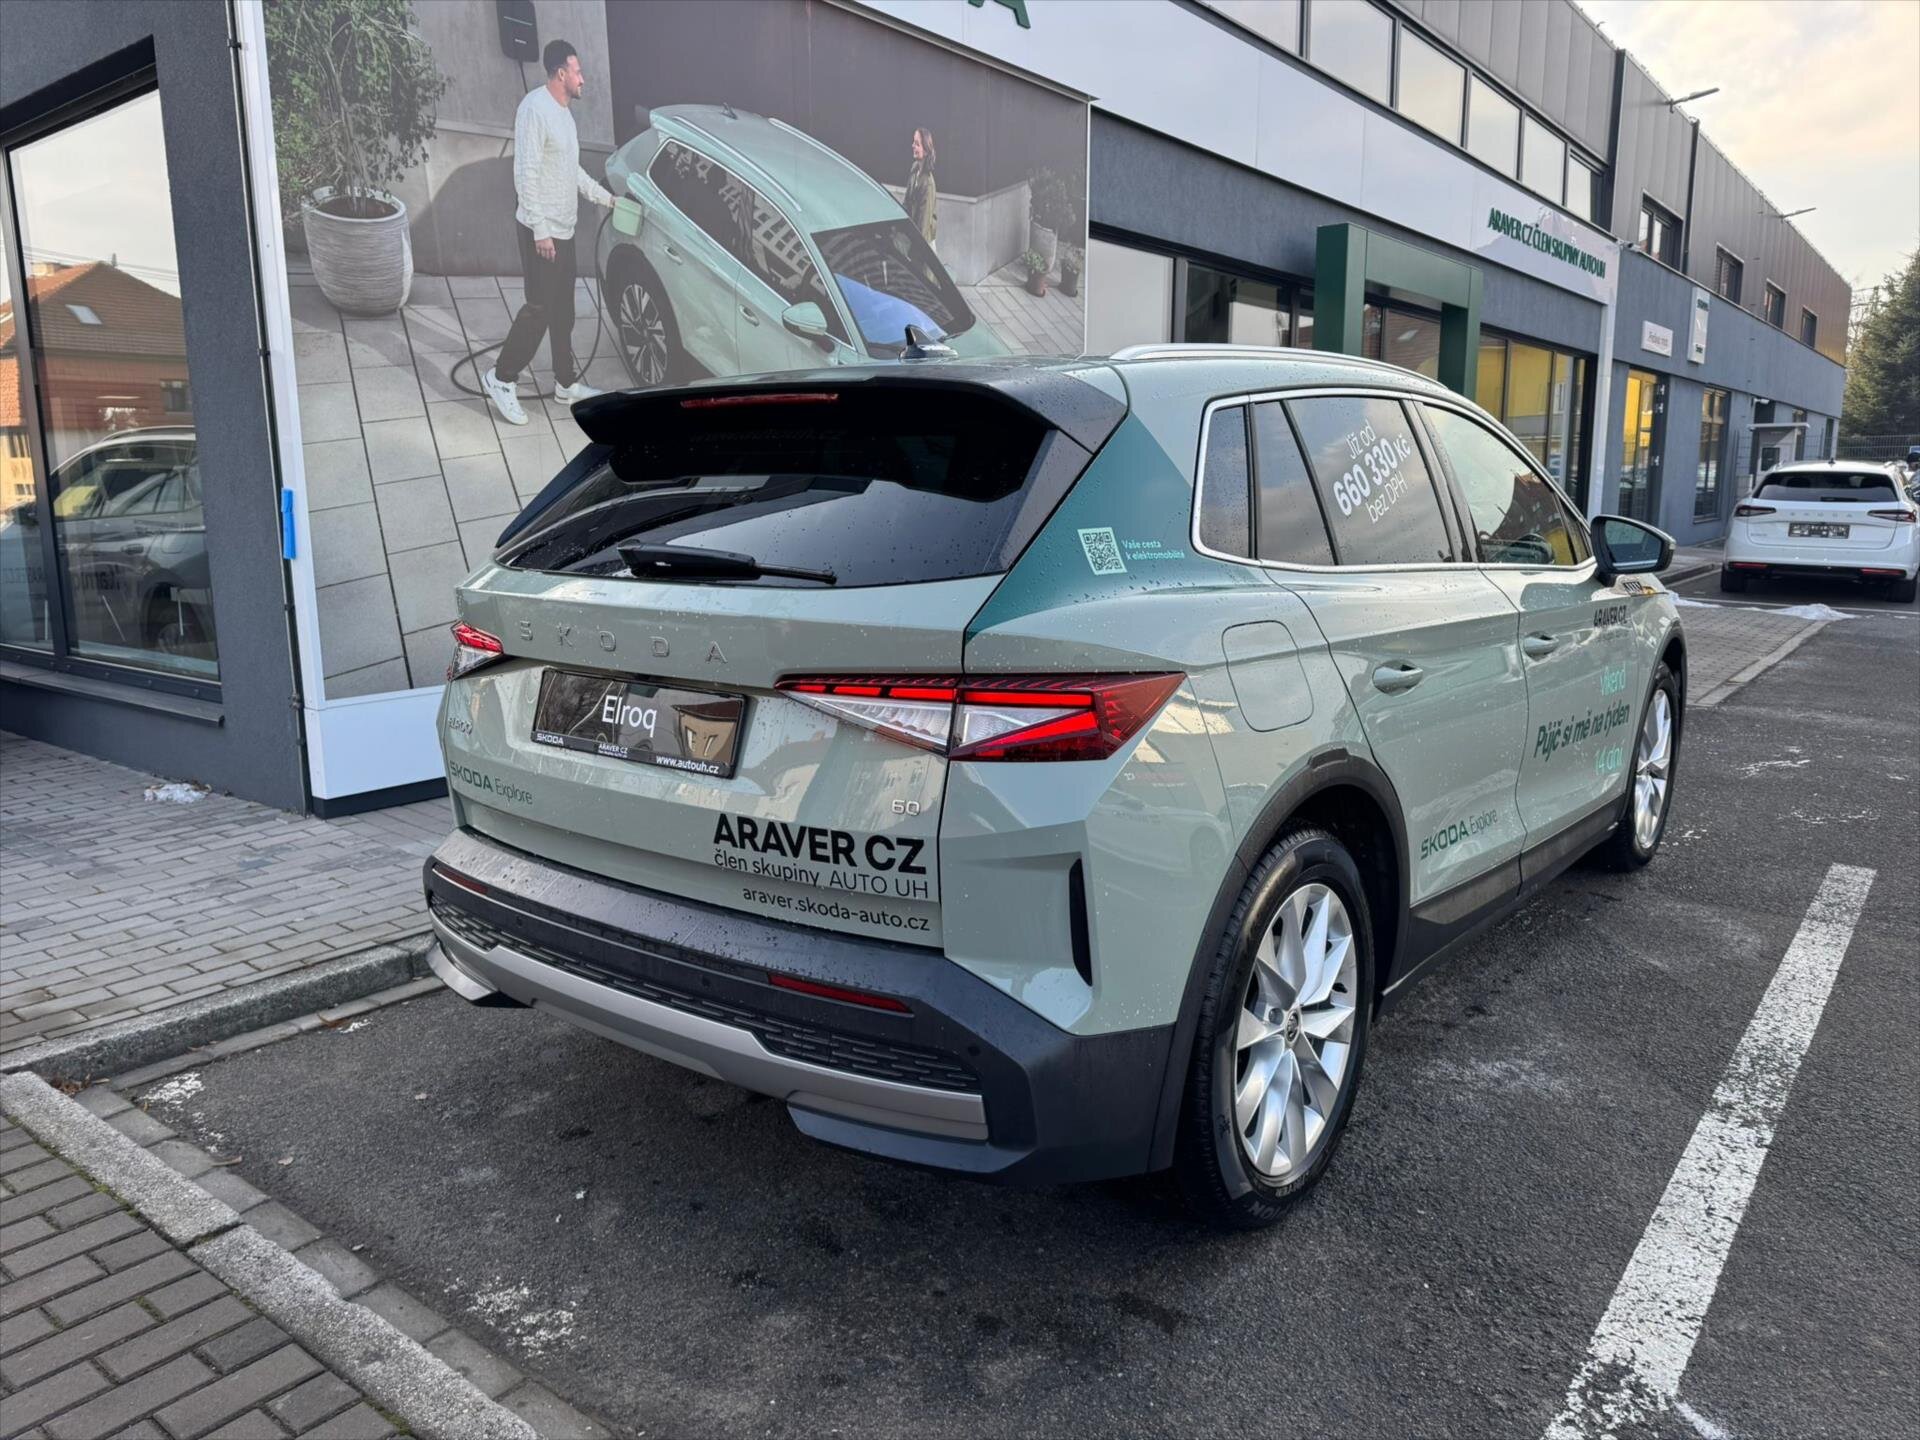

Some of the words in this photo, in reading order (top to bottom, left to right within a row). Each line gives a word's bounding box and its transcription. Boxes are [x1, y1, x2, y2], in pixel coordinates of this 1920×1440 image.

[1488, 208, 1521, 241] ARAVER
[1521, 223, 1533, 246] CZ
[1532, 223, 1552, 255] ČLEN
[1551, 238, 1581, 267] SKUPINY
[1346, 432, 1363, 459] Již
[1360, 419, 1376, 446] od
[1333, 464, 1370, 516] 660
[1364, 438, 1397, 485] 330
[1393, 433, 1410, 462] Kč
[1365, 494, 1389, 523] bez
[1384, 471, 1408, 504] DPH
[1125, 551, 1131, 560] k
[1142, 540, 1161, 549] cesta
[1593, 607, 1617, 628] ARAVER
[1618, 604, 1628, 624] CZ
[601, 695, 657, 738] Elroq
[1533, 718, 1562, 762] Půjč
[1561, 715, 1575, 747] si
[1572, 709, 1592, 743] mě
[1590, 713, 1604, 736] na
[1603, 701, 1630, 737] týden
[598, 743, 619, 753] ARAVER
[655, 755, 720, 775] www.autouh.cz
[495, 778, 533, 804] Explore
[891, 800, 920, 816] 60
[1470, 809, 1498, 835] Explore
[713, 813, 857, 867] ARAVER
[864, 834, 927, 875] CZ
[714, 848, 748, 872] člen
[753, 857, 820, 887] skupiny
[829, 870, 888, 894] AUTO
[895, 879, 929, 899] UH
[742, 887, 931, 931] araver.skoda-auto.cz
